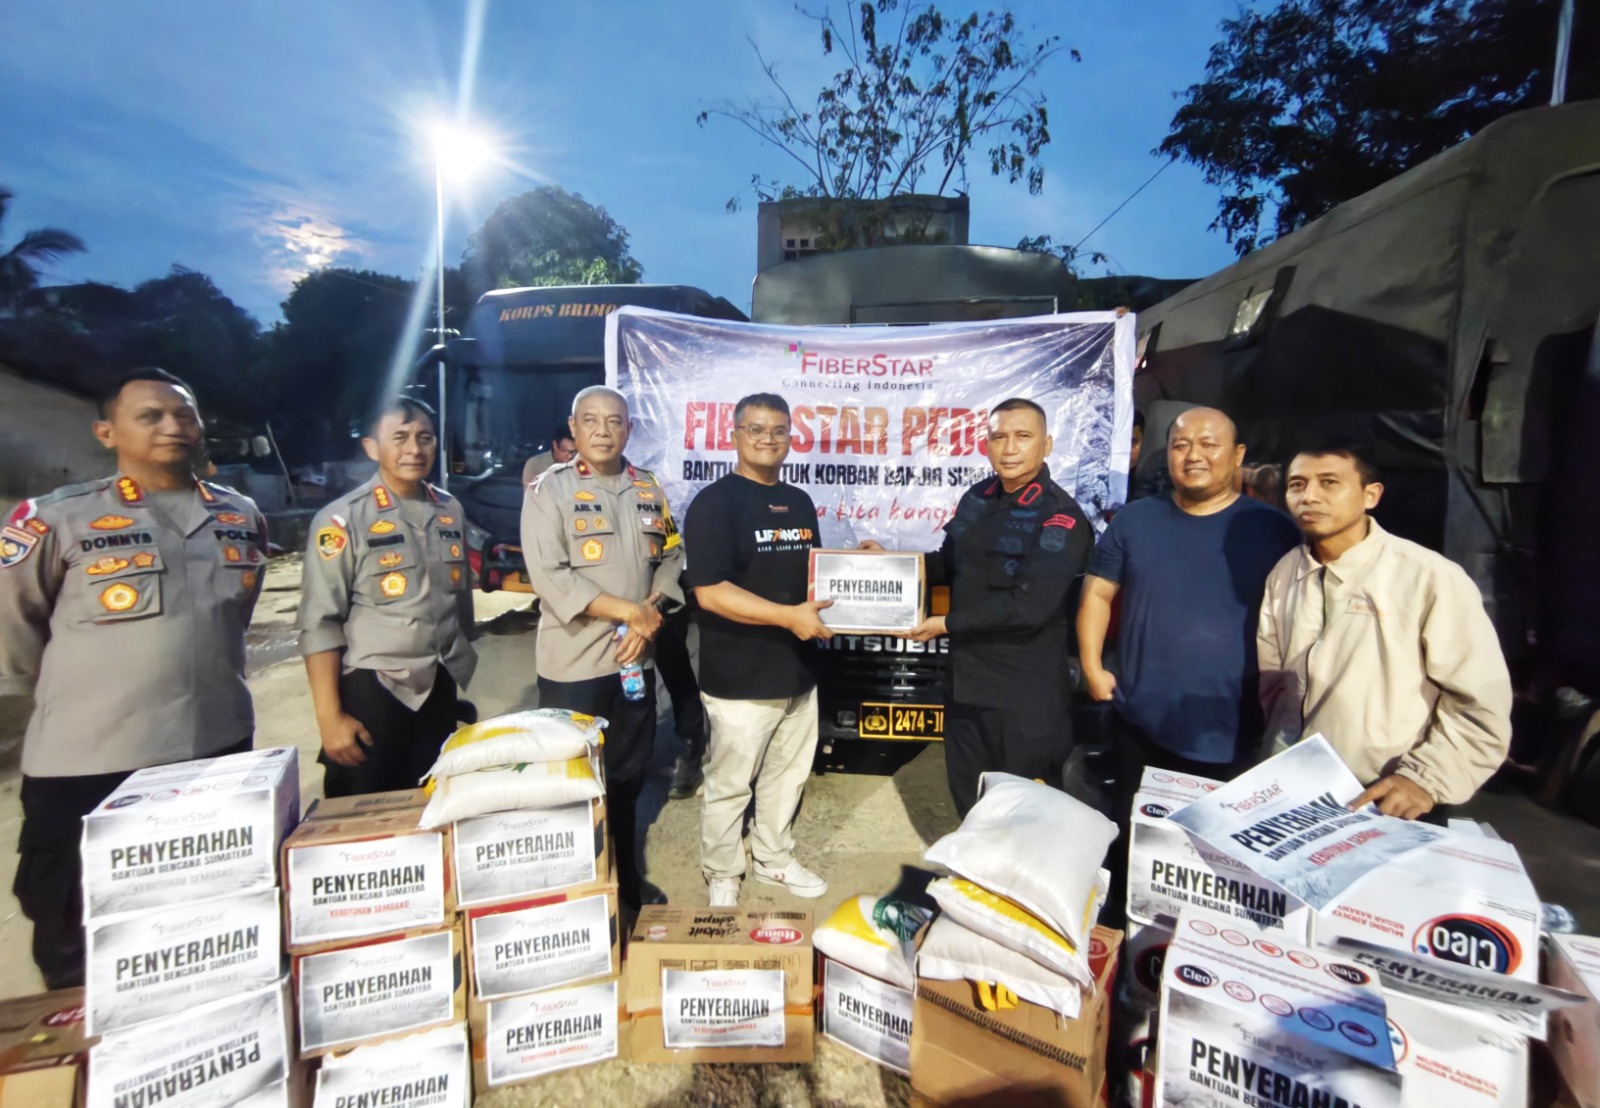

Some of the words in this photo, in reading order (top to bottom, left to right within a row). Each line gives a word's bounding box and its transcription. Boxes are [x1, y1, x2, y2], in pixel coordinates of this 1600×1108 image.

[498, 304, 555, 322] KORPS
[557, 304, 616, 317] BRIMO
[802, 352, 933, 377] FIBERSTAR
[684, 402, 888, 456] FIBSTAR
[683, 460, 738, 482] BANTU
[815, 464, 880, 486] KORBAN
[889, 497, 958, 534] bang
[829, 579, 903, 595] PENYERAHAN
[816, 635, 950, 654] MITSUBIS
[1145, 805, 1168, 817] Cleo
[111, 826, 253, 870] PENYERAHAN
[476, 831, 575, 862] PENYERAHAN
[112, 866, 155, 881] BANTUAN
[158, 857, 201, 874] BENCANA
[204, 848, 253, 866] SUMATERA
[313, 864, 425, 896] PENYERAHAN
[477, 860, 507, 871] BANTUAN
[313, 895, 347, 906] BANTUAN
[350, 890, 383, 902] BENCANA
[386, 884, 425, 898] SUMATERA
[1151, 859, 1287, 918] PENYERAHAN
[1151, 883, 1188, 902] BANTUAN
[1191, 896, 1232, 915] BENCANA
[1234, 907, 1285, 930] SUMATERA
[495, 928, 590, 961] PENYERAHAN
[755, 929, 796, 942] Roma
[1432, 926, 1498, 971] Cleo
[116, 925, 259, 981] PENYERAHAN
[496, 958, 525, 970] BANTUAN
[116, 975, 161, 992] BANTUAN
[164, 964, 206, 982] BENCANA
[209, 950, 258, 971] SUMATERA
[323, 965, 432, 1003] PENYERAHAN
[1182, 967, 1210, 985] Cleo
[324, 999, 357, 1013] BANTUAN
[359, 992, 392, 1006] BENCANA
[394, 983, 432, 998] SUMATERA
[680, 998, 769, 1017] PENYERAHAN
[506, 1013, 602, 1047] PENYERAHAN
[838, 992, 914, 1037] PENYERAHA
[113, 1042, 261, 1108] PENYERAHAN
[1189, 1069, 1240, 1100] BANTUAN
